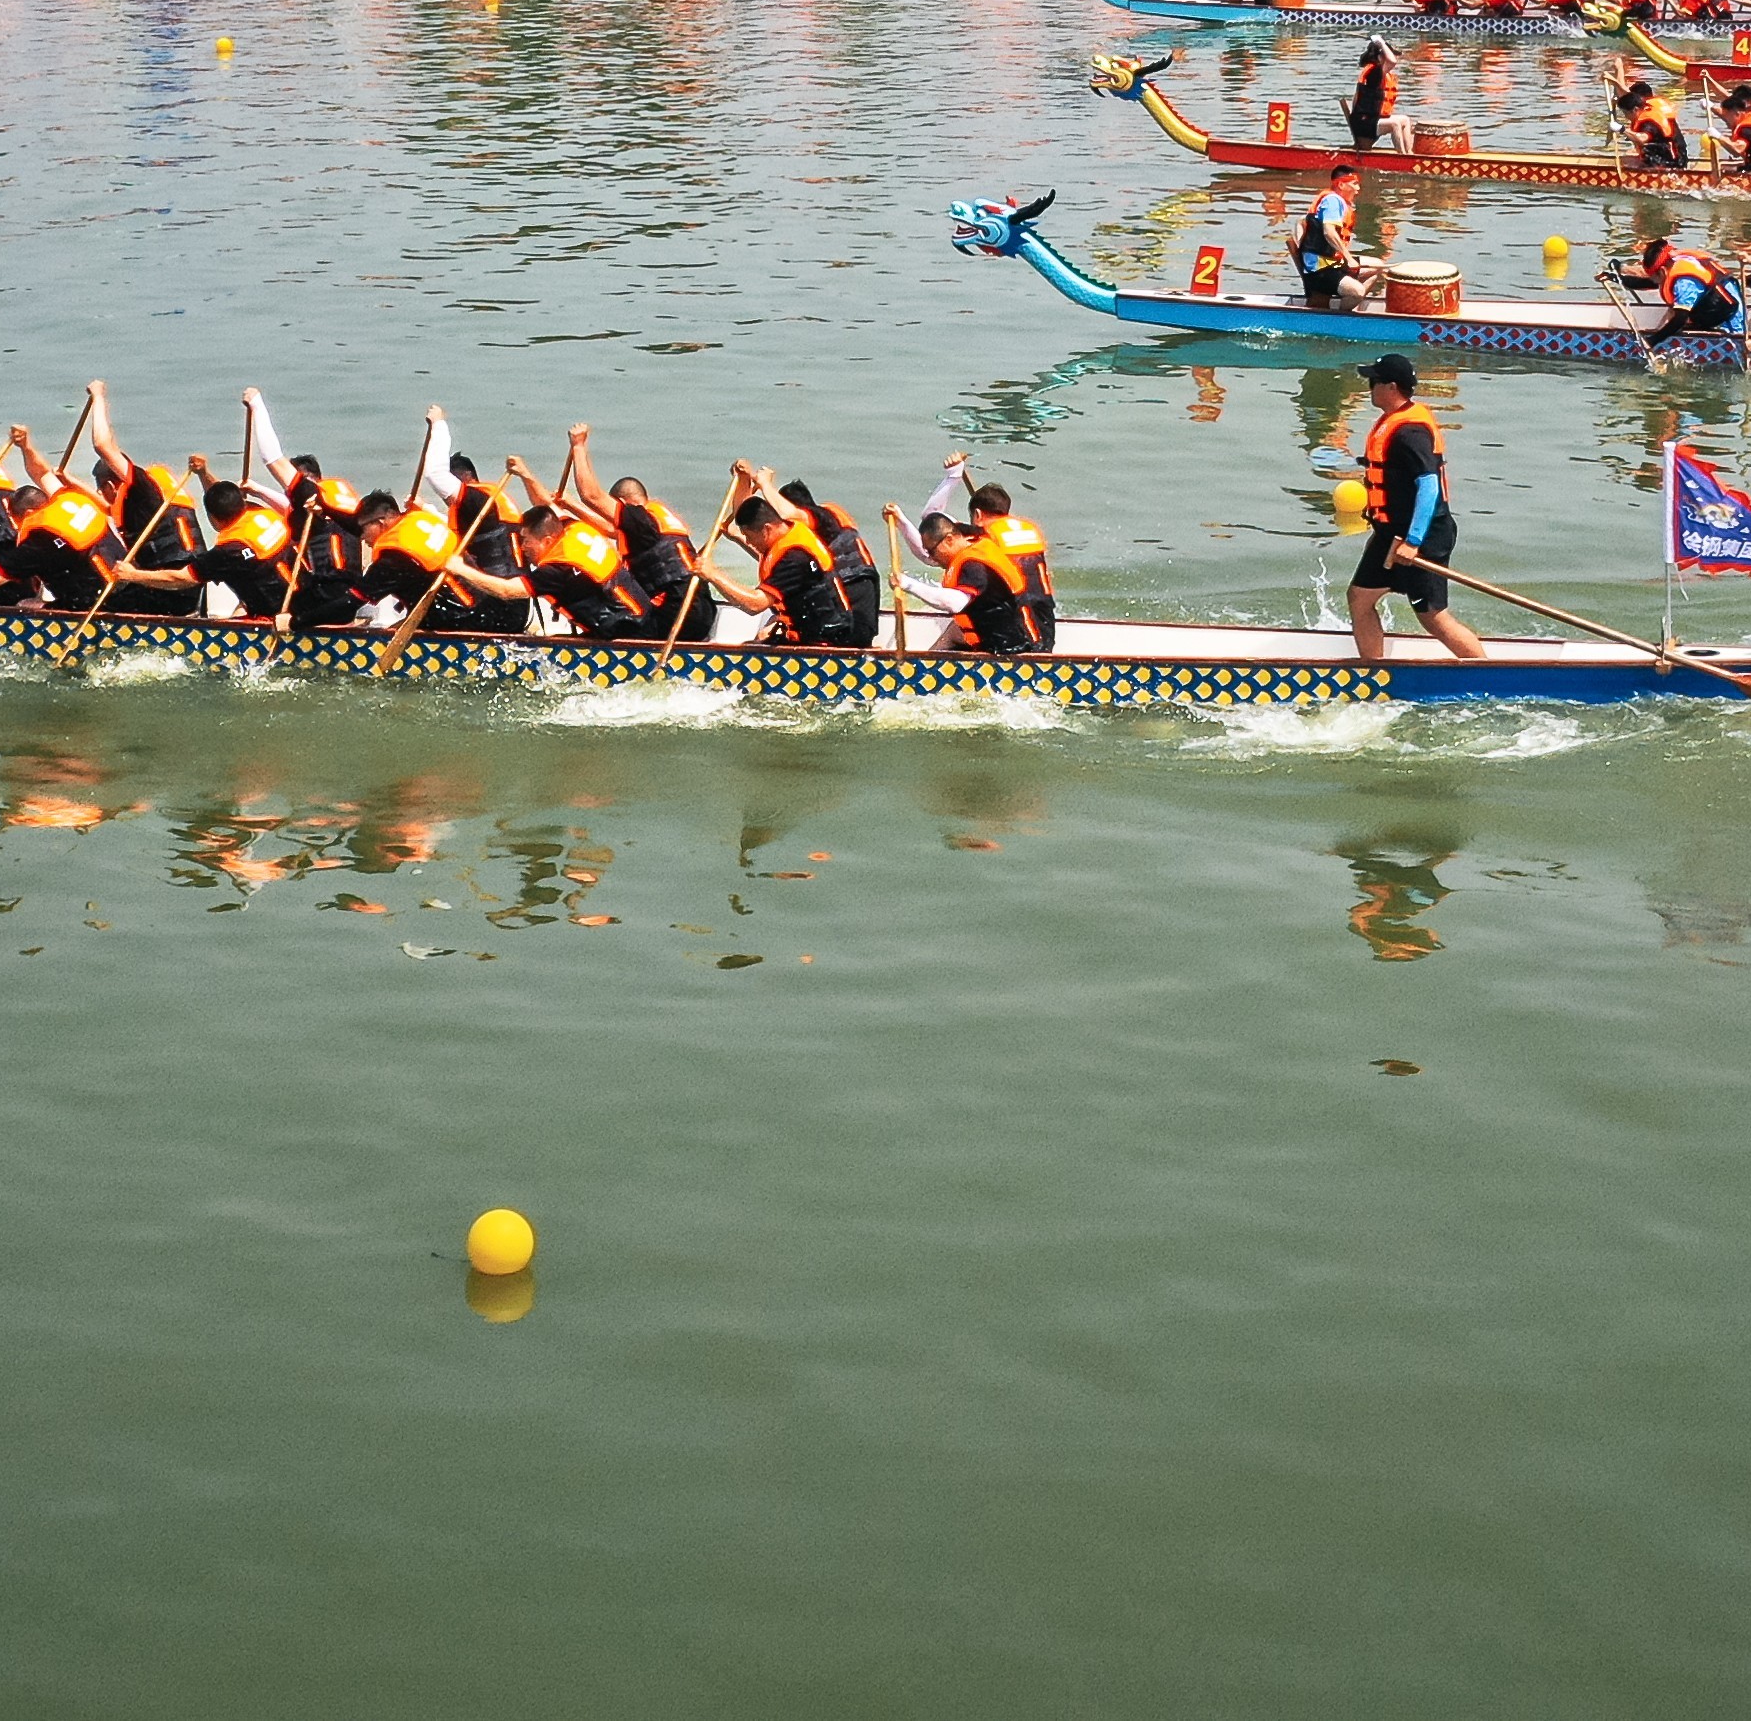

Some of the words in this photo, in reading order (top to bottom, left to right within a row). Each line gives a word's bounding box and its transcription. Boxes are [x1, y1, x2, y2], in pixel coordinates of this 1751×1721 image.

[1735, 37, 1750, 56] 4
[1270, 109, 1286, 133] 3
[1194, 255, 1217, 285] 2
